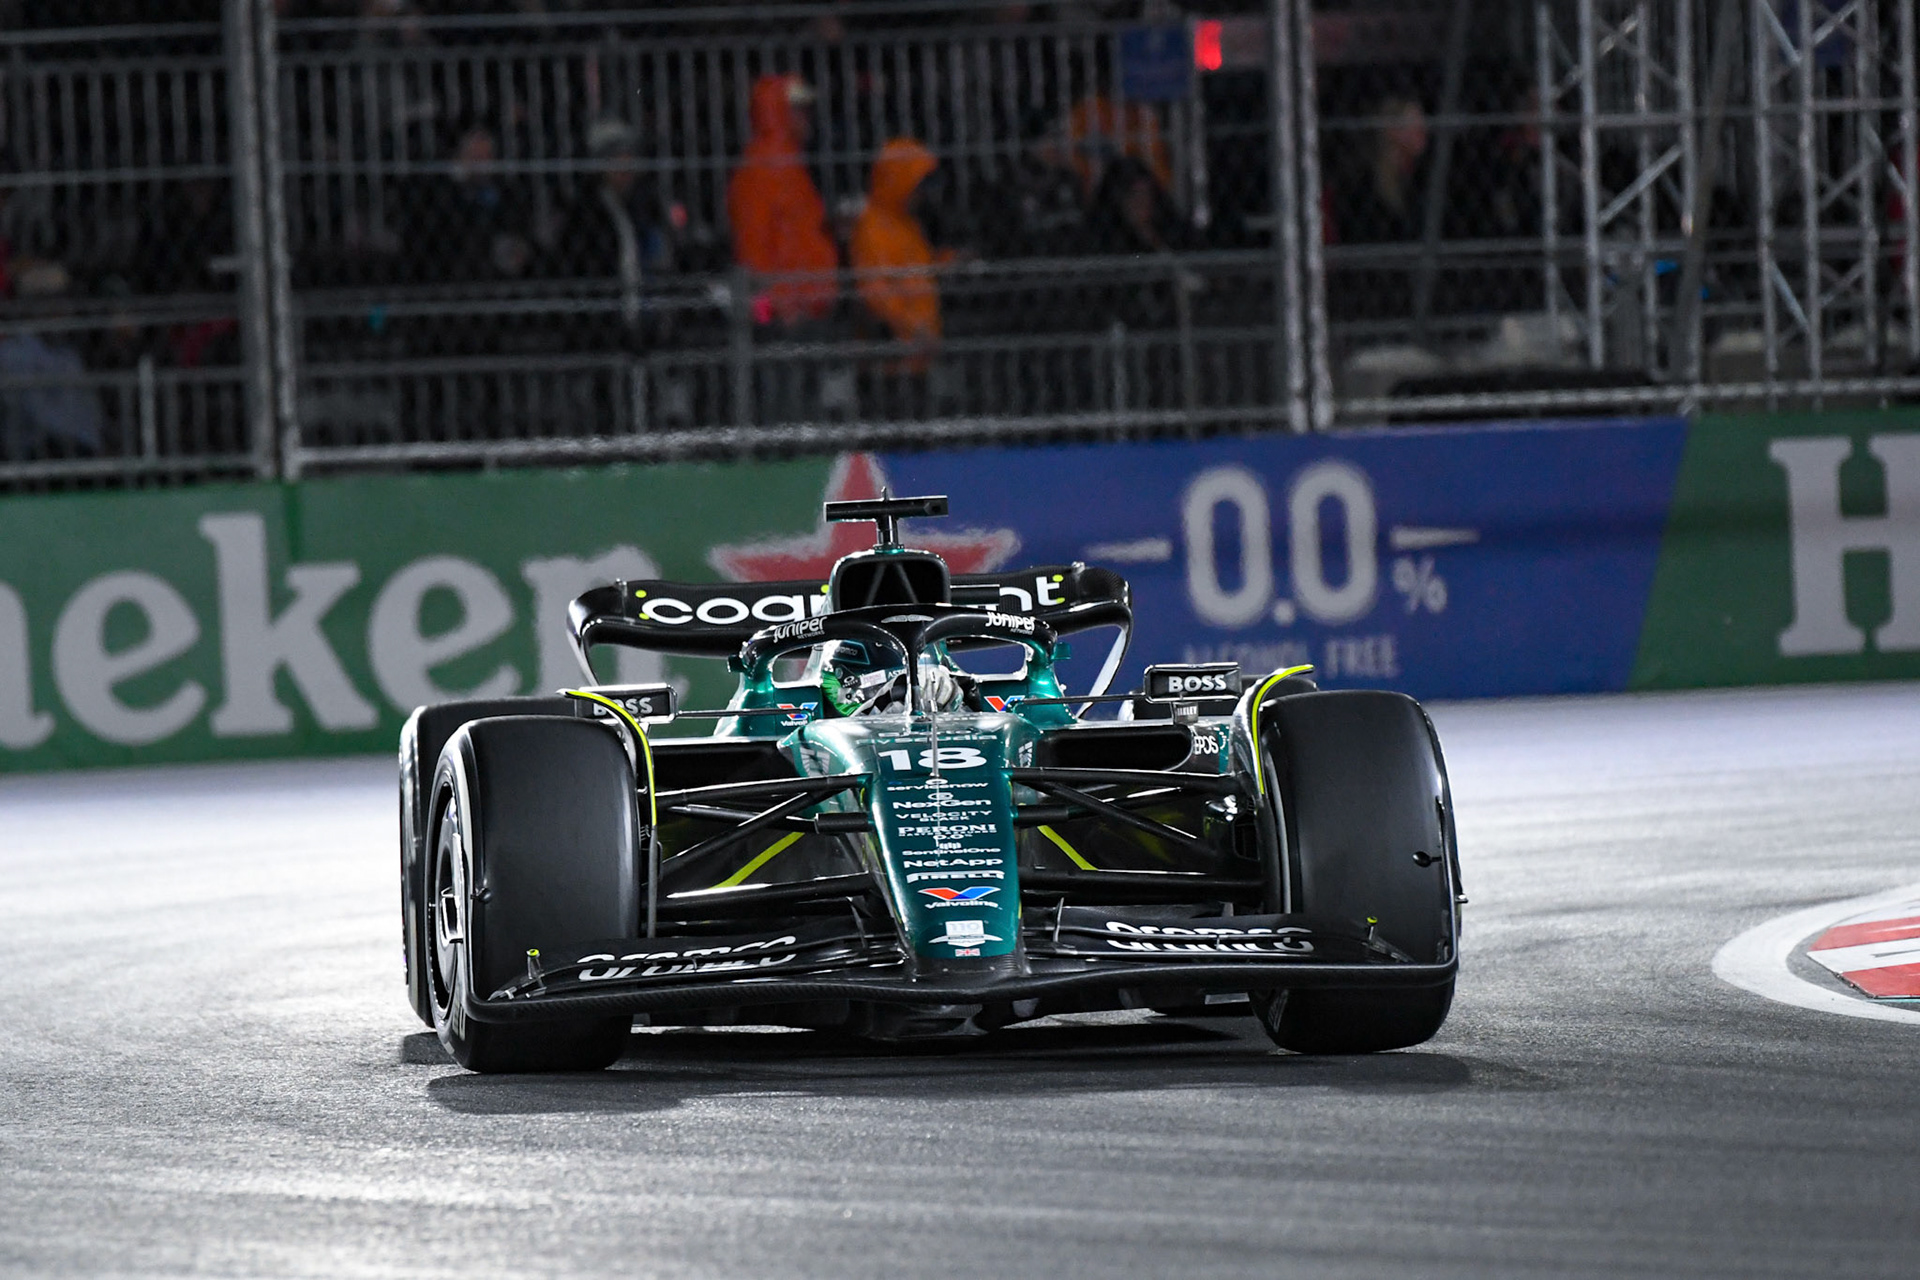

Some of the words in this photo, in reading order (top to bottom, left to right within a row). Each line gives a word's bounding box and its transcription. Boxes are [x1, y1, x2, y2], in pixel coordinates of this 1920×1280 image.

[641, 576, 1064, 625] cognt
[1168, 674, 1227, 693] BOSS
[1193, 735, 1219, 755] EPOS
[878, 747, 988, 771] 18
[893, 799, 992, 810] NexGen
[896, 810, 992, 819] VELOCITY
[898, 824, 997, 834] PERONI
[903, 859, 1004, 868] NetApp
[924, 900, 999, 909] Valvoline
